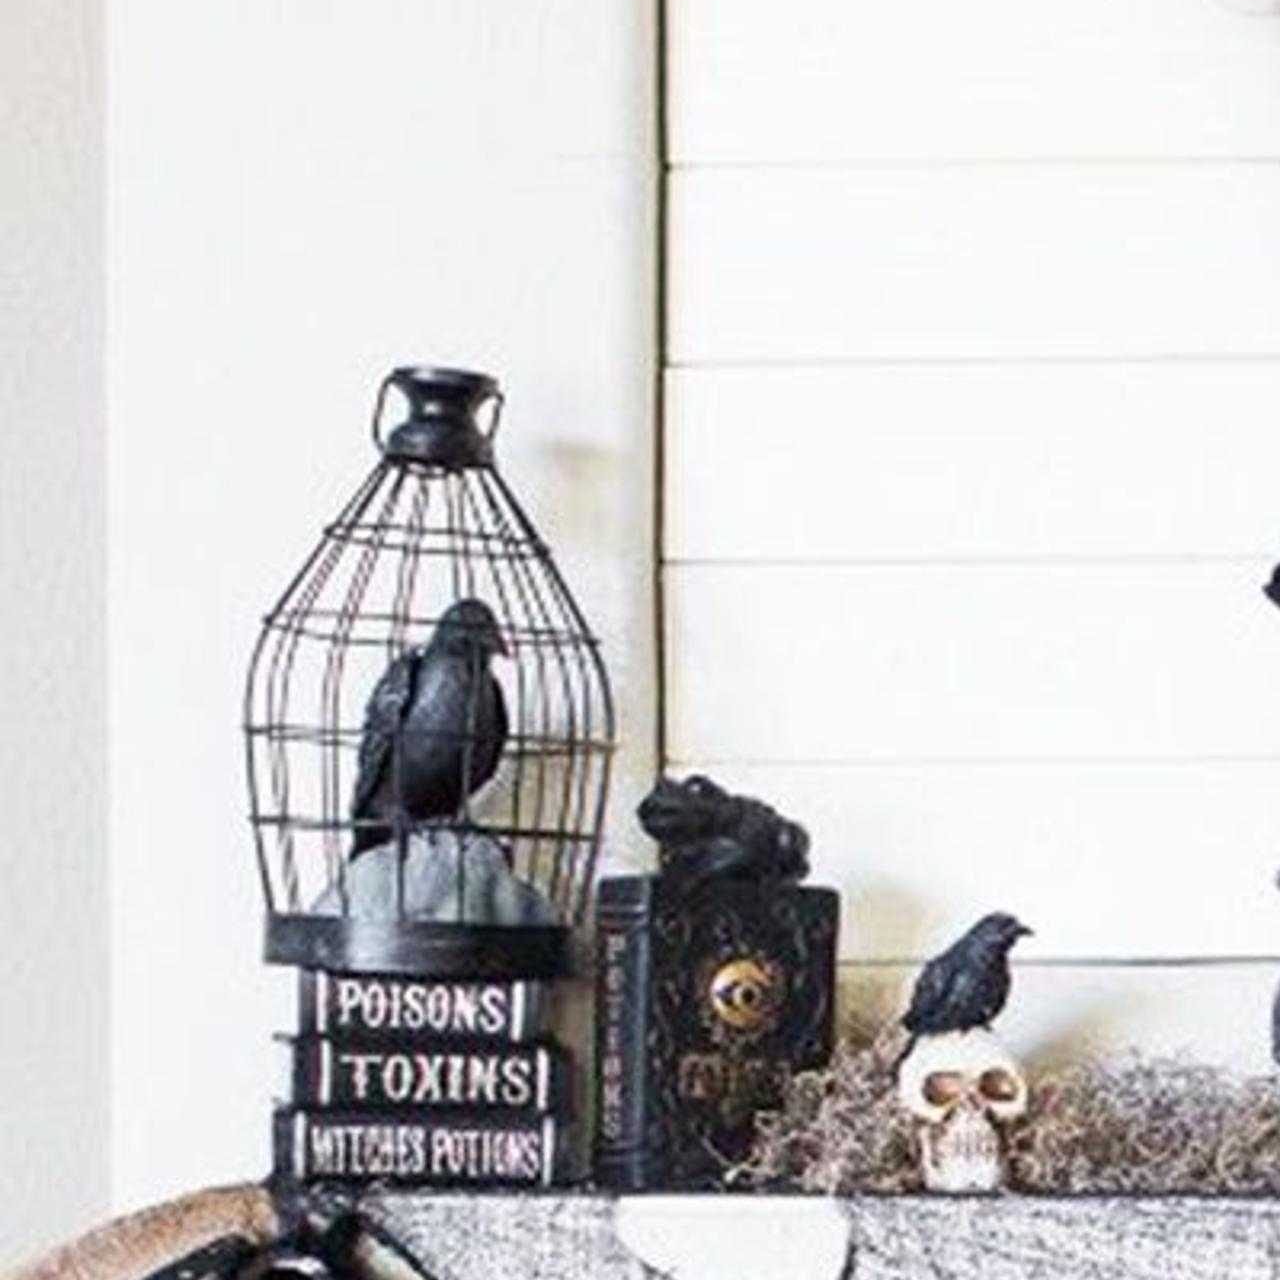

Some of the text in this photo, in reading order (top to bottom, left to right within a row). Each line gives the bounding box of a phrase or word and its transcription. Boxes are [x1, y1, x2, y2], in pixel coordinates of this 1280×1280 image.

[337, 979, 506, 1034] POISONS
[339, 1054, 533, 1106] TOXINS
[431, 1126, 541, 1180] POTIONS
